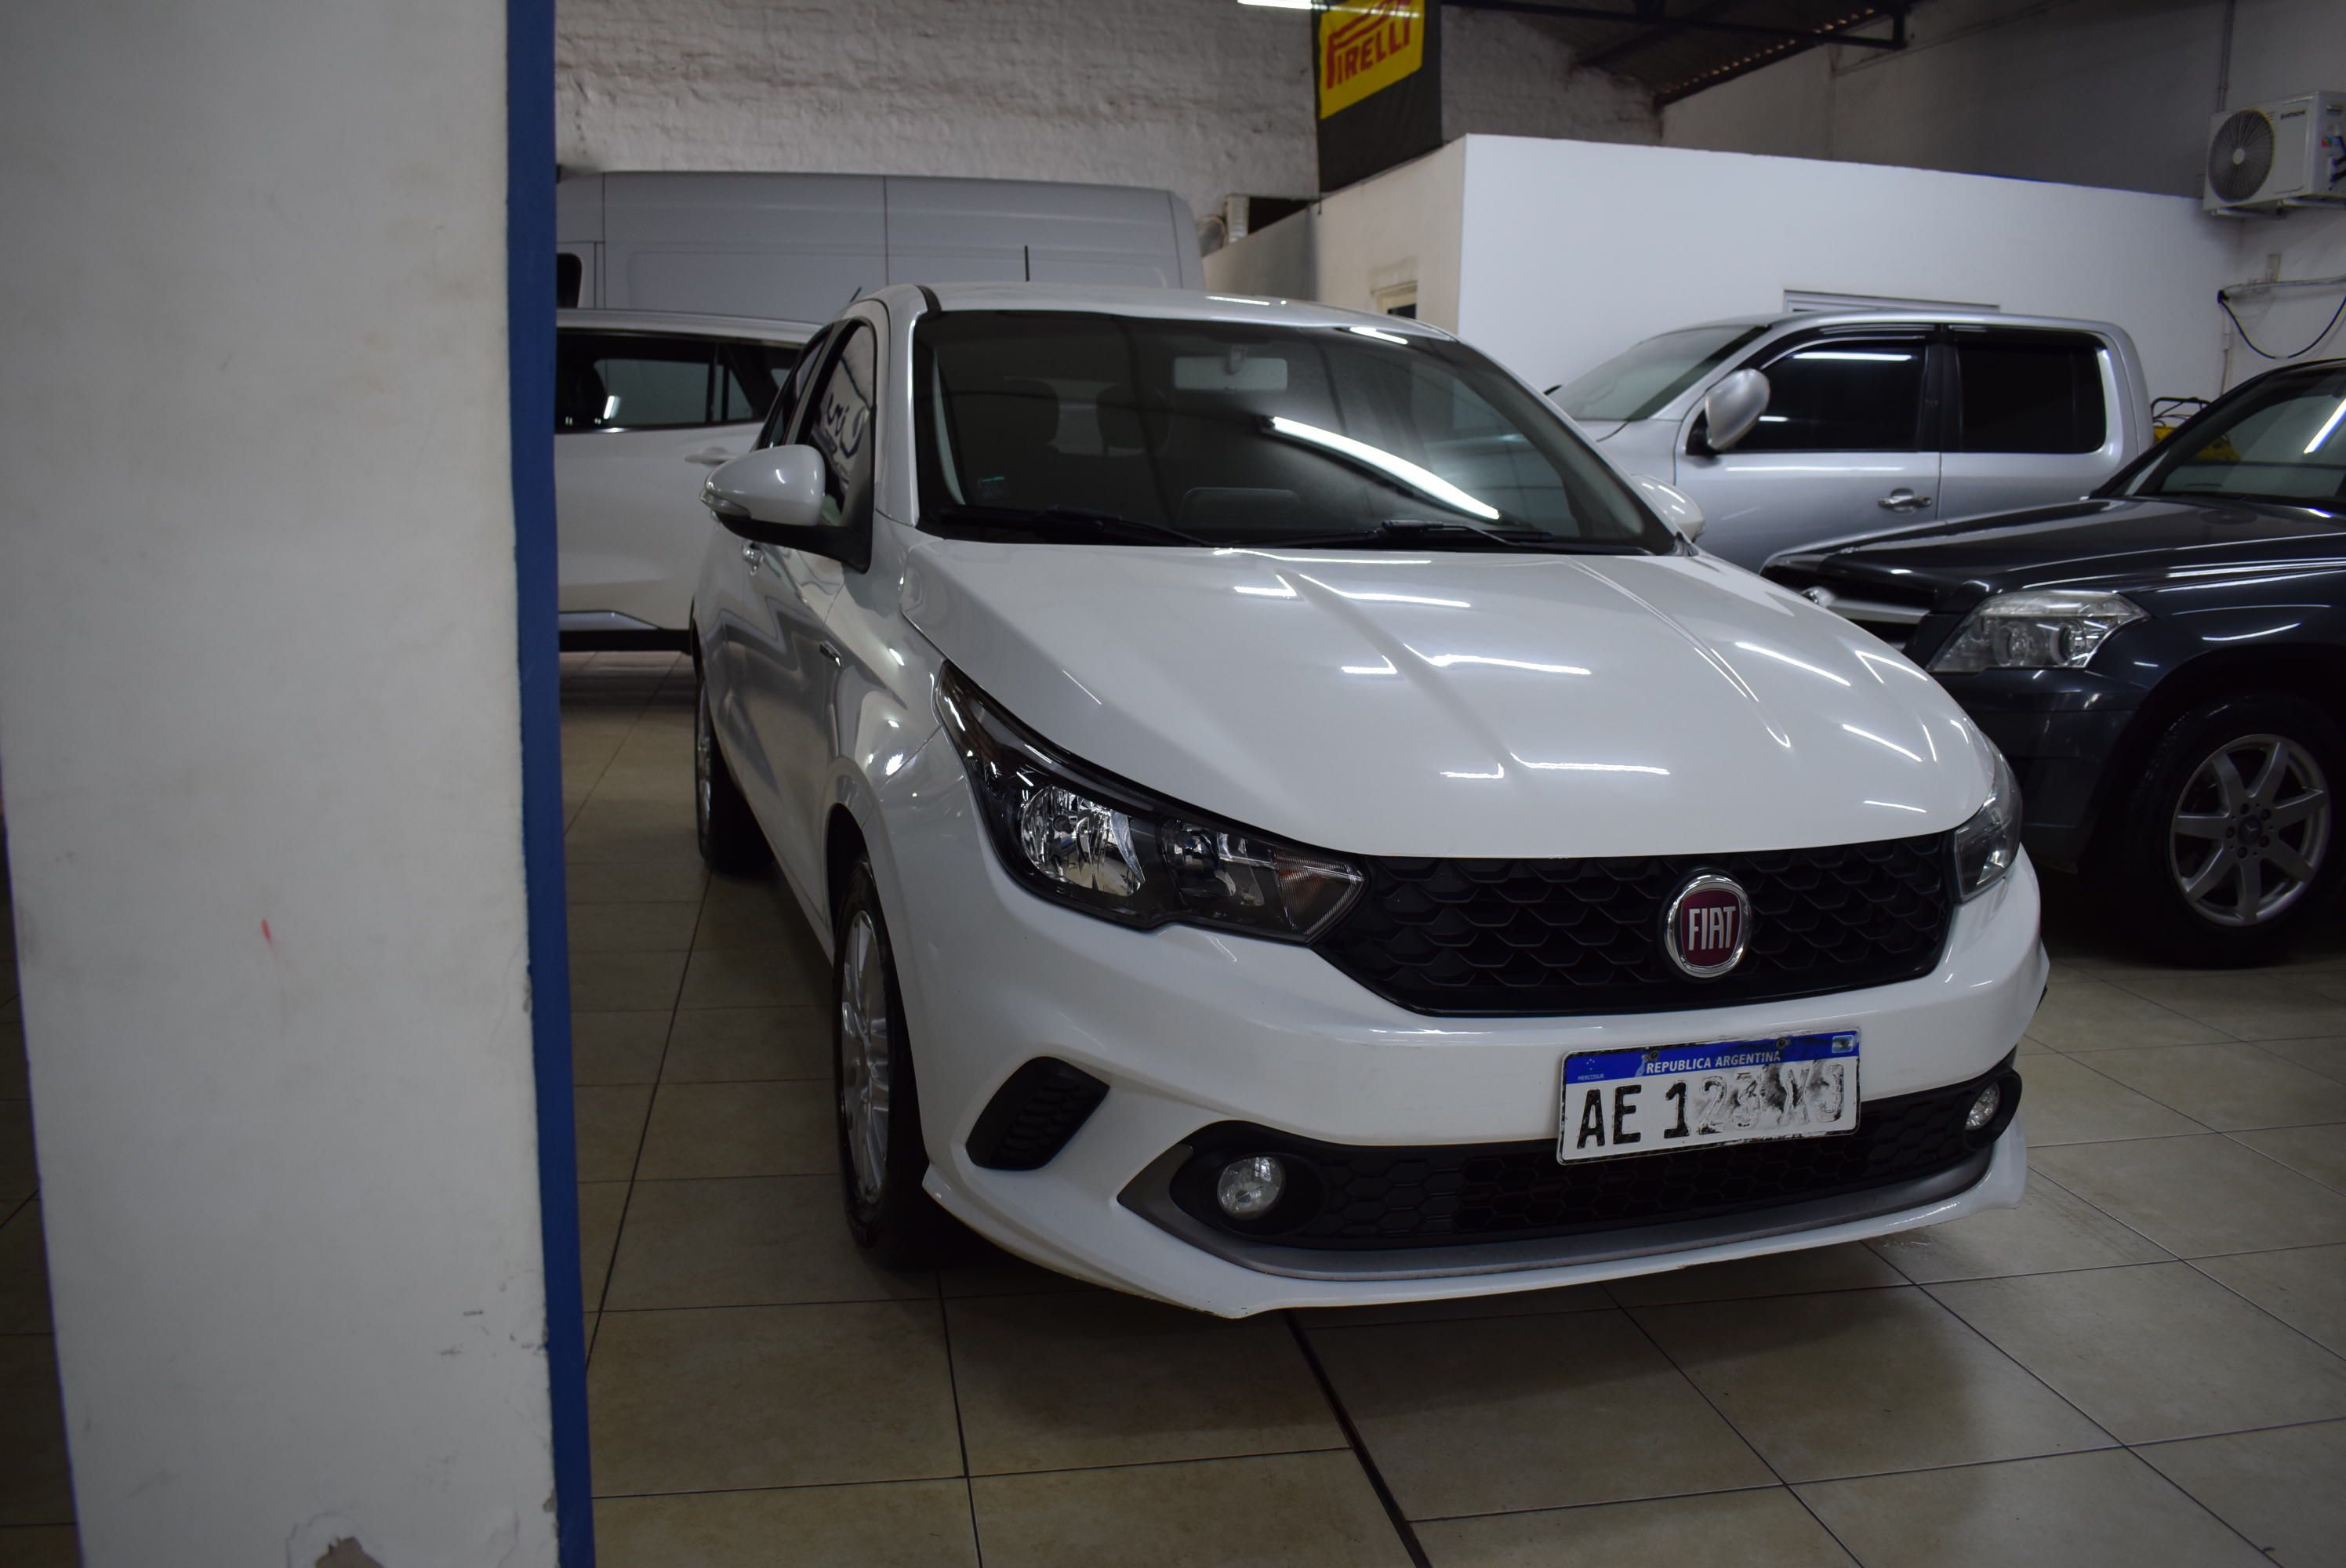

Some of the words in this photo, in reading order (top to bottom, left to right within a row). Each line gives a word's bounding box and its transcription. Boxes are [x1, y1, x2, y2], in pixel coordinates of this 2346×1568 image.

[1326, 0, 1413, 89] PIRELLI
[1688, 906, 1736, 950] FIAT
[1647, 1057, 1712, 1074] REPUBLICA
[1715, 1051, 1781, 1067] ARGENTINA
[1577, 1084, 1642, 1149] AE
